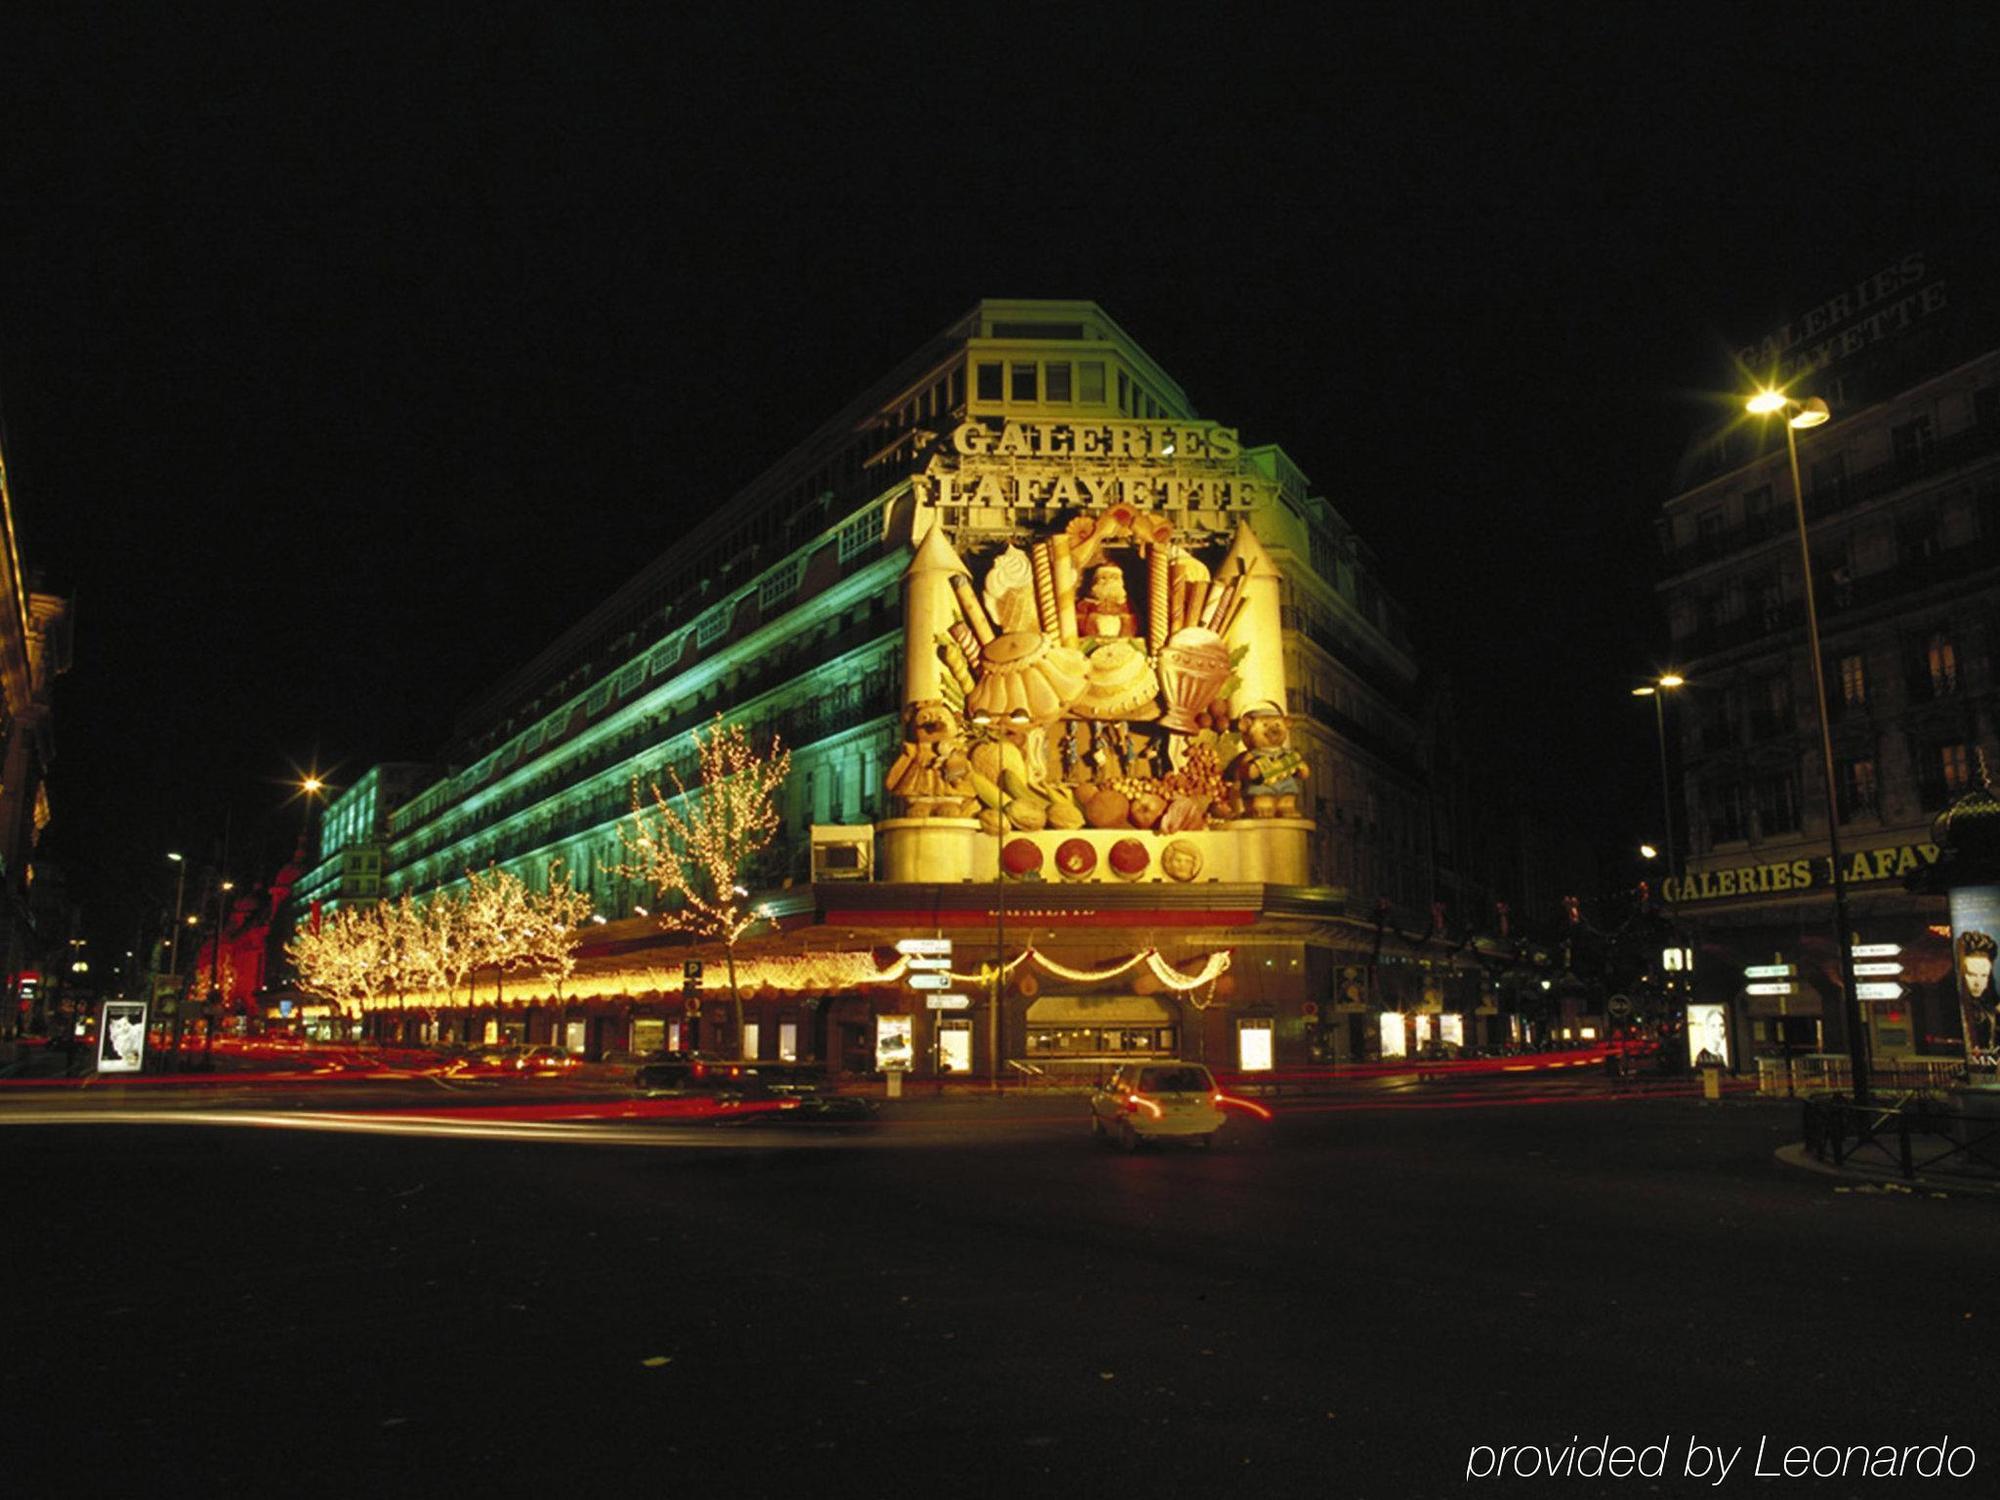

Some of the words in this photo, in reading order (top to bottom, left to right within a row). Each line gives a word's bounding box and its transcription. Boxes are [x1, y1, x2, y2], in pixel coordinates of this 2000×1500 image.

[953, 422, 1239, 460] GALERIES
[934, 475, 1258, 511] LAFAYETTE
[1662, 859, 1812, 901] GALERIES
